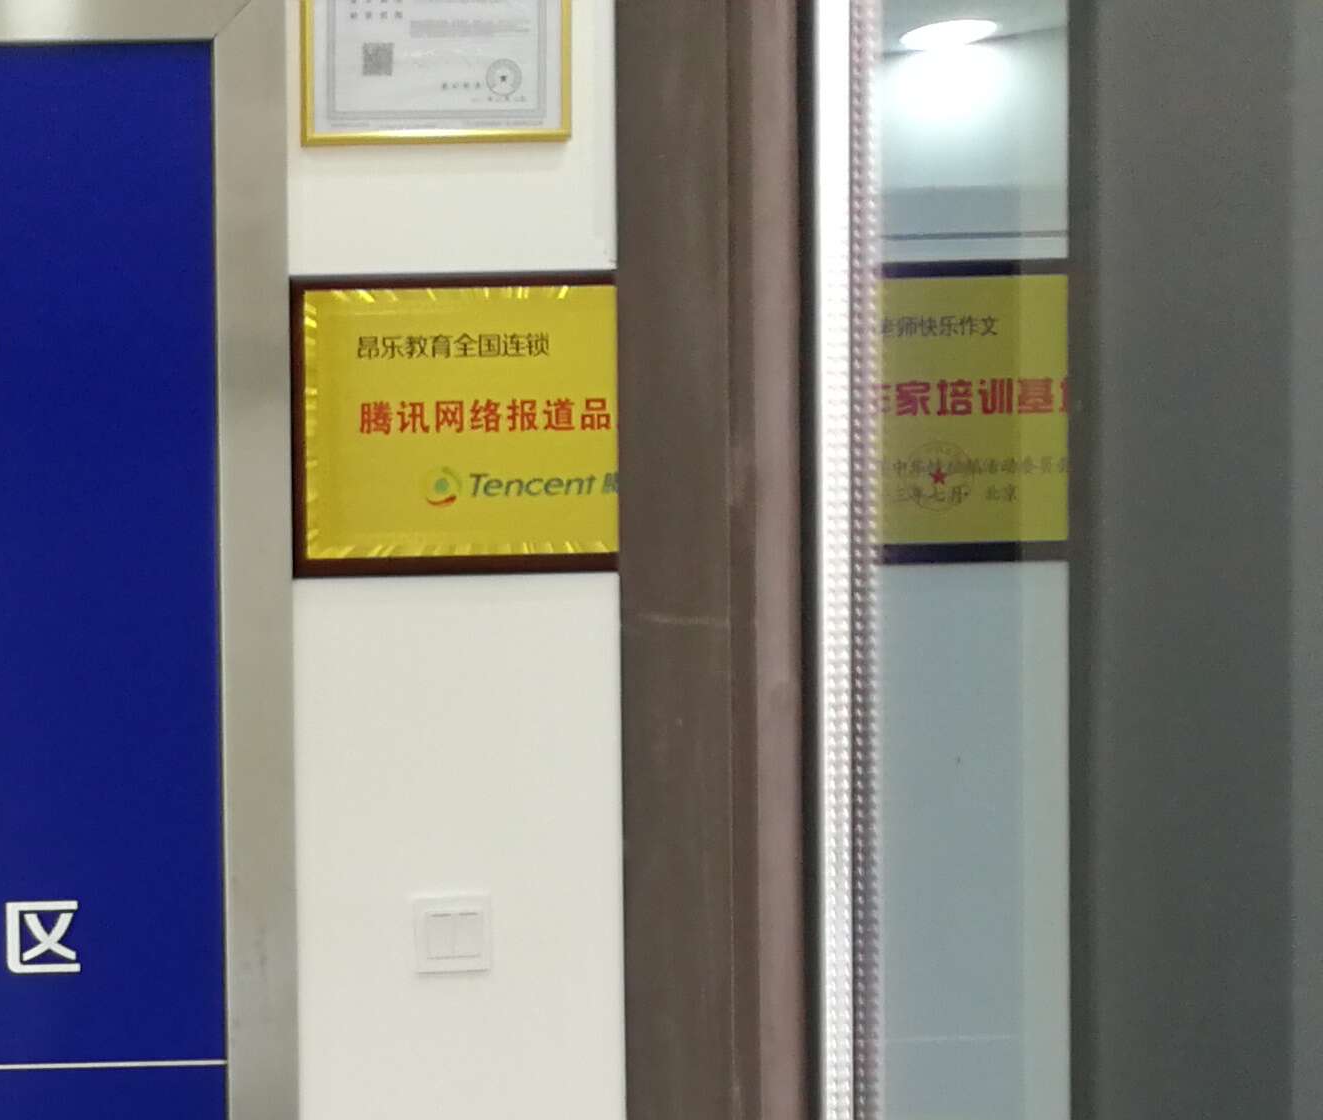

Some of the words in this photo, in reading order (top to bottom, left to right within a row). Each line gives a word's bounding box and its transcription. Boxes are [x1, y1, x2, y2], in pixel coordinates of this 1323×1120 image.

[357, 333, 550, 360] 昂乐教育全国连锁
[873, 377, 1068, 417] 家培训基
[360, 397, 618, 436] 腾讯网络报道品
[469, 472, 596, 498] Tencent
